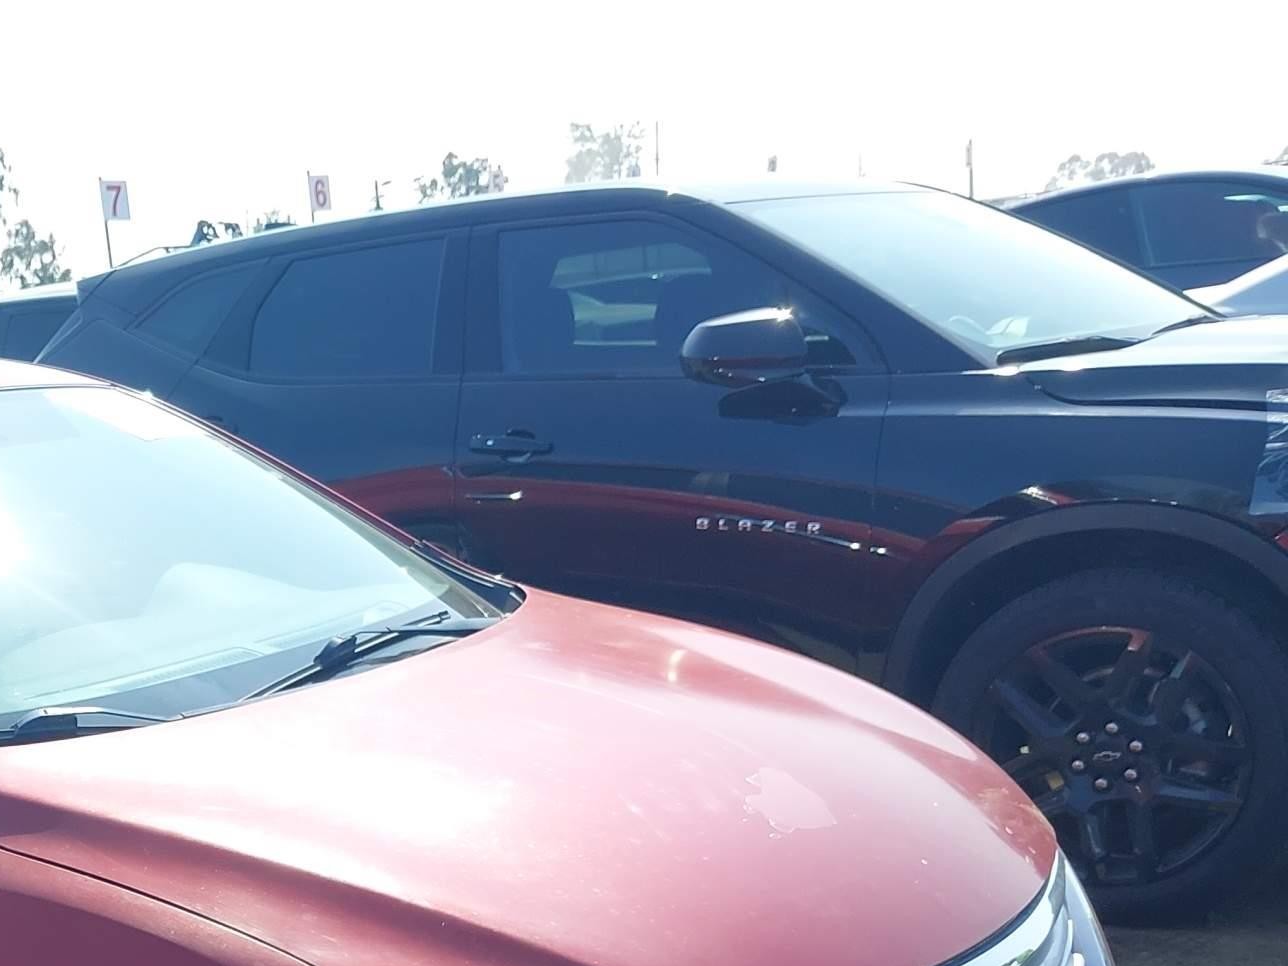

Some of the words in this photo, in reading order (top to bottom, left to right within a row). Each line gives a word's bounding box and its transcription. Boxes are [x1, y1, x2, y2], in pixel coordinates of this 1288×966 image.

[106, 185, 122, 218] 7
[314, 179, 328, 208] 6
[695, 516, 822, 535] BLAZER
